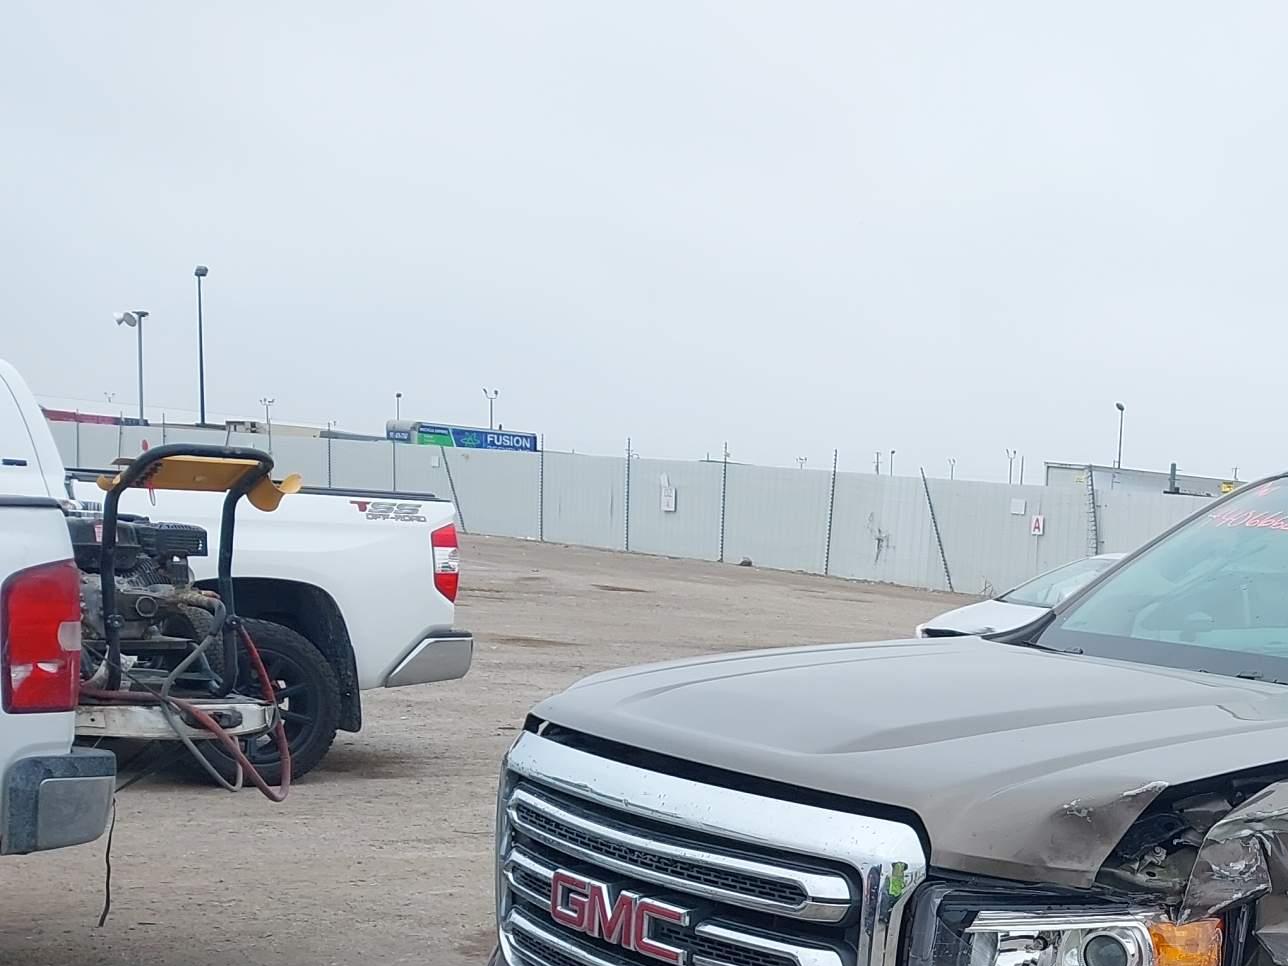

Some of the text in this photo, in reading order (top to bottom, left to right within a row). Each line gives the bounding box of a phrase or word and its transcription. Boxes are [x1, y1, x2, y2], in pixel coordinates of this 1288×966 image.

[486, 433, 531, 449] FUSION
[349, 500, 422, 515] TSS
[1032, 516, 1041, 533] A
